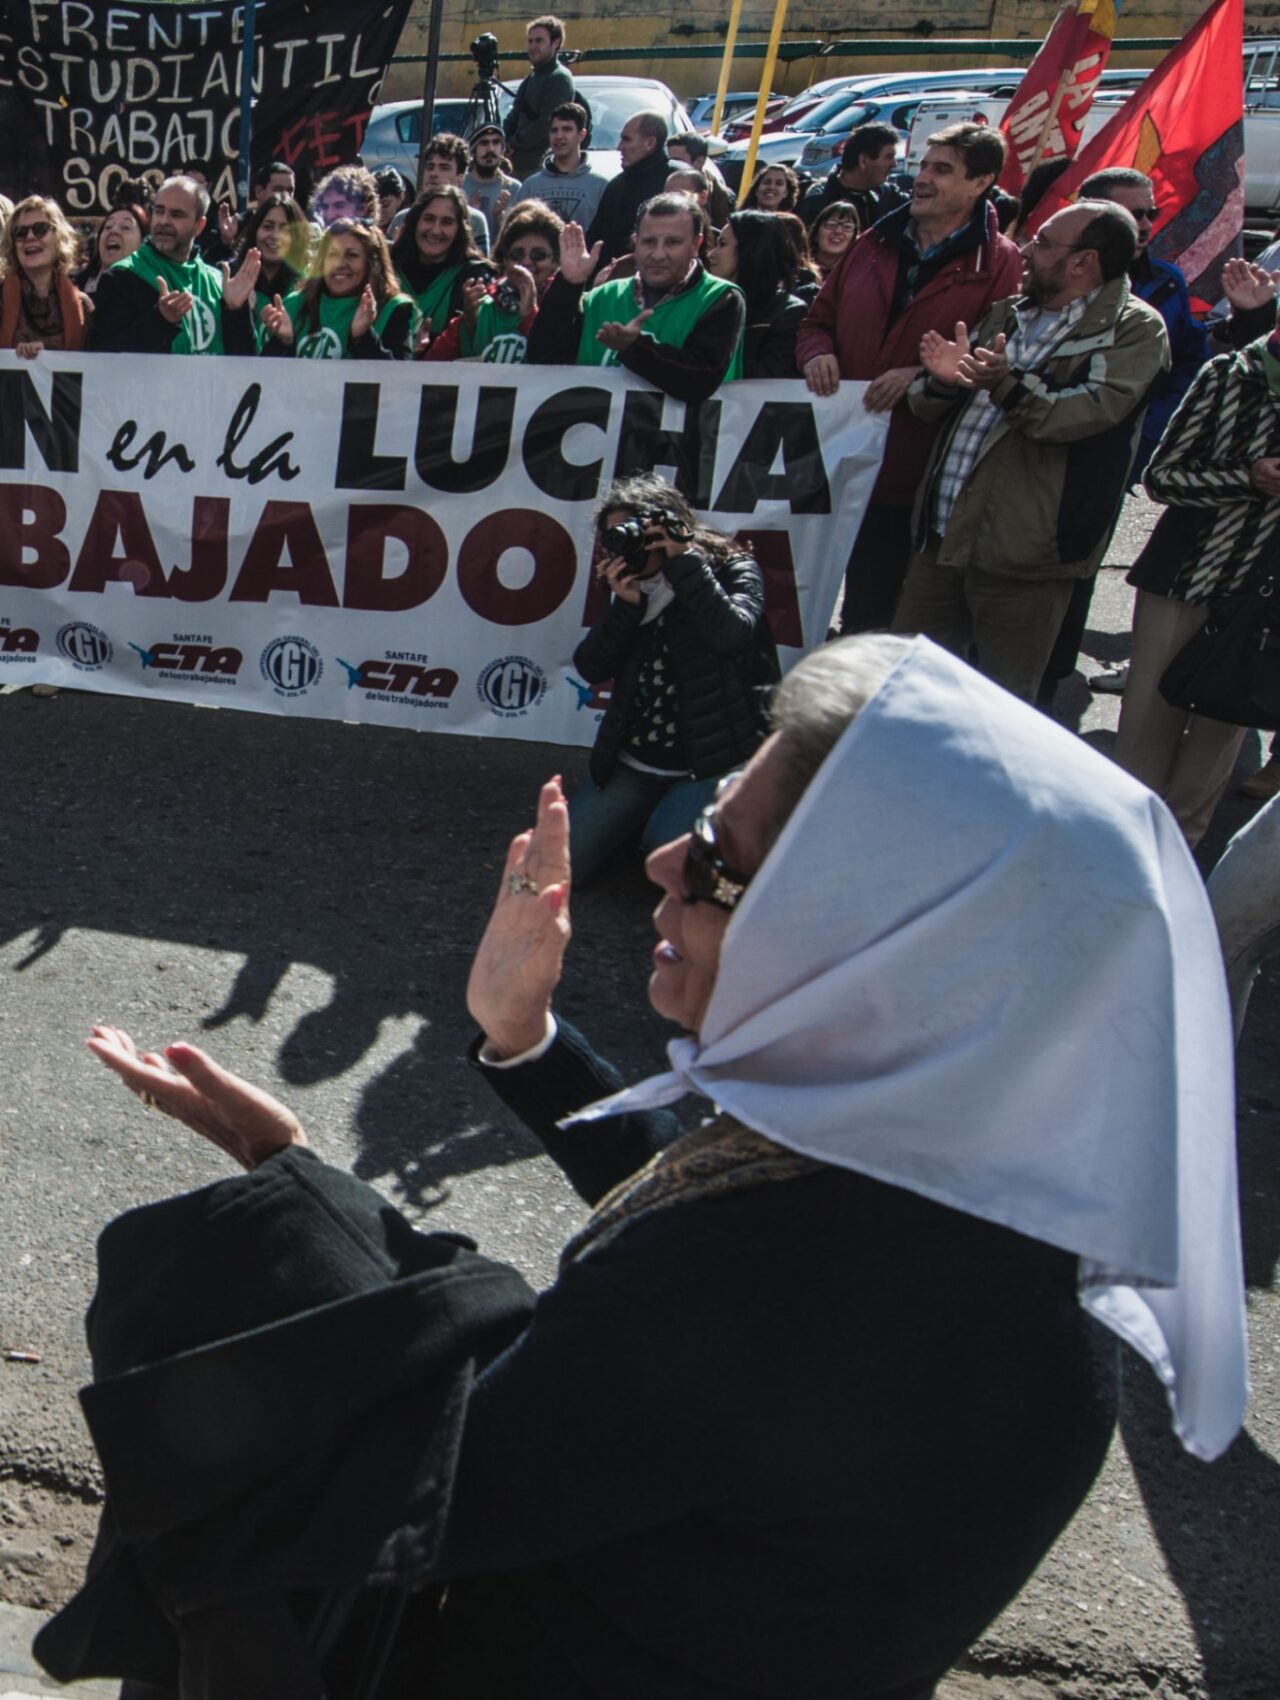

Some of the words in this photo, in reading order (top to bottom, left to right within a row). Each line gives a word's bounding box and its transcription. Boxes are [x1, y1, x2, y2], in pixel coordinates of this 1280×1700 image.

[29, 0, 266, 50] FRENTE
[106, 420, 196, 479] en
[216, 383, 301, 485] la
[335, 382, 832, 515] LUCHA
[149, 643, 243, 675] CTA
[269, 642, 315, 689] CGT
[356, 660, 459, 698] CTA
[485, 662, 540, 708] CGT
